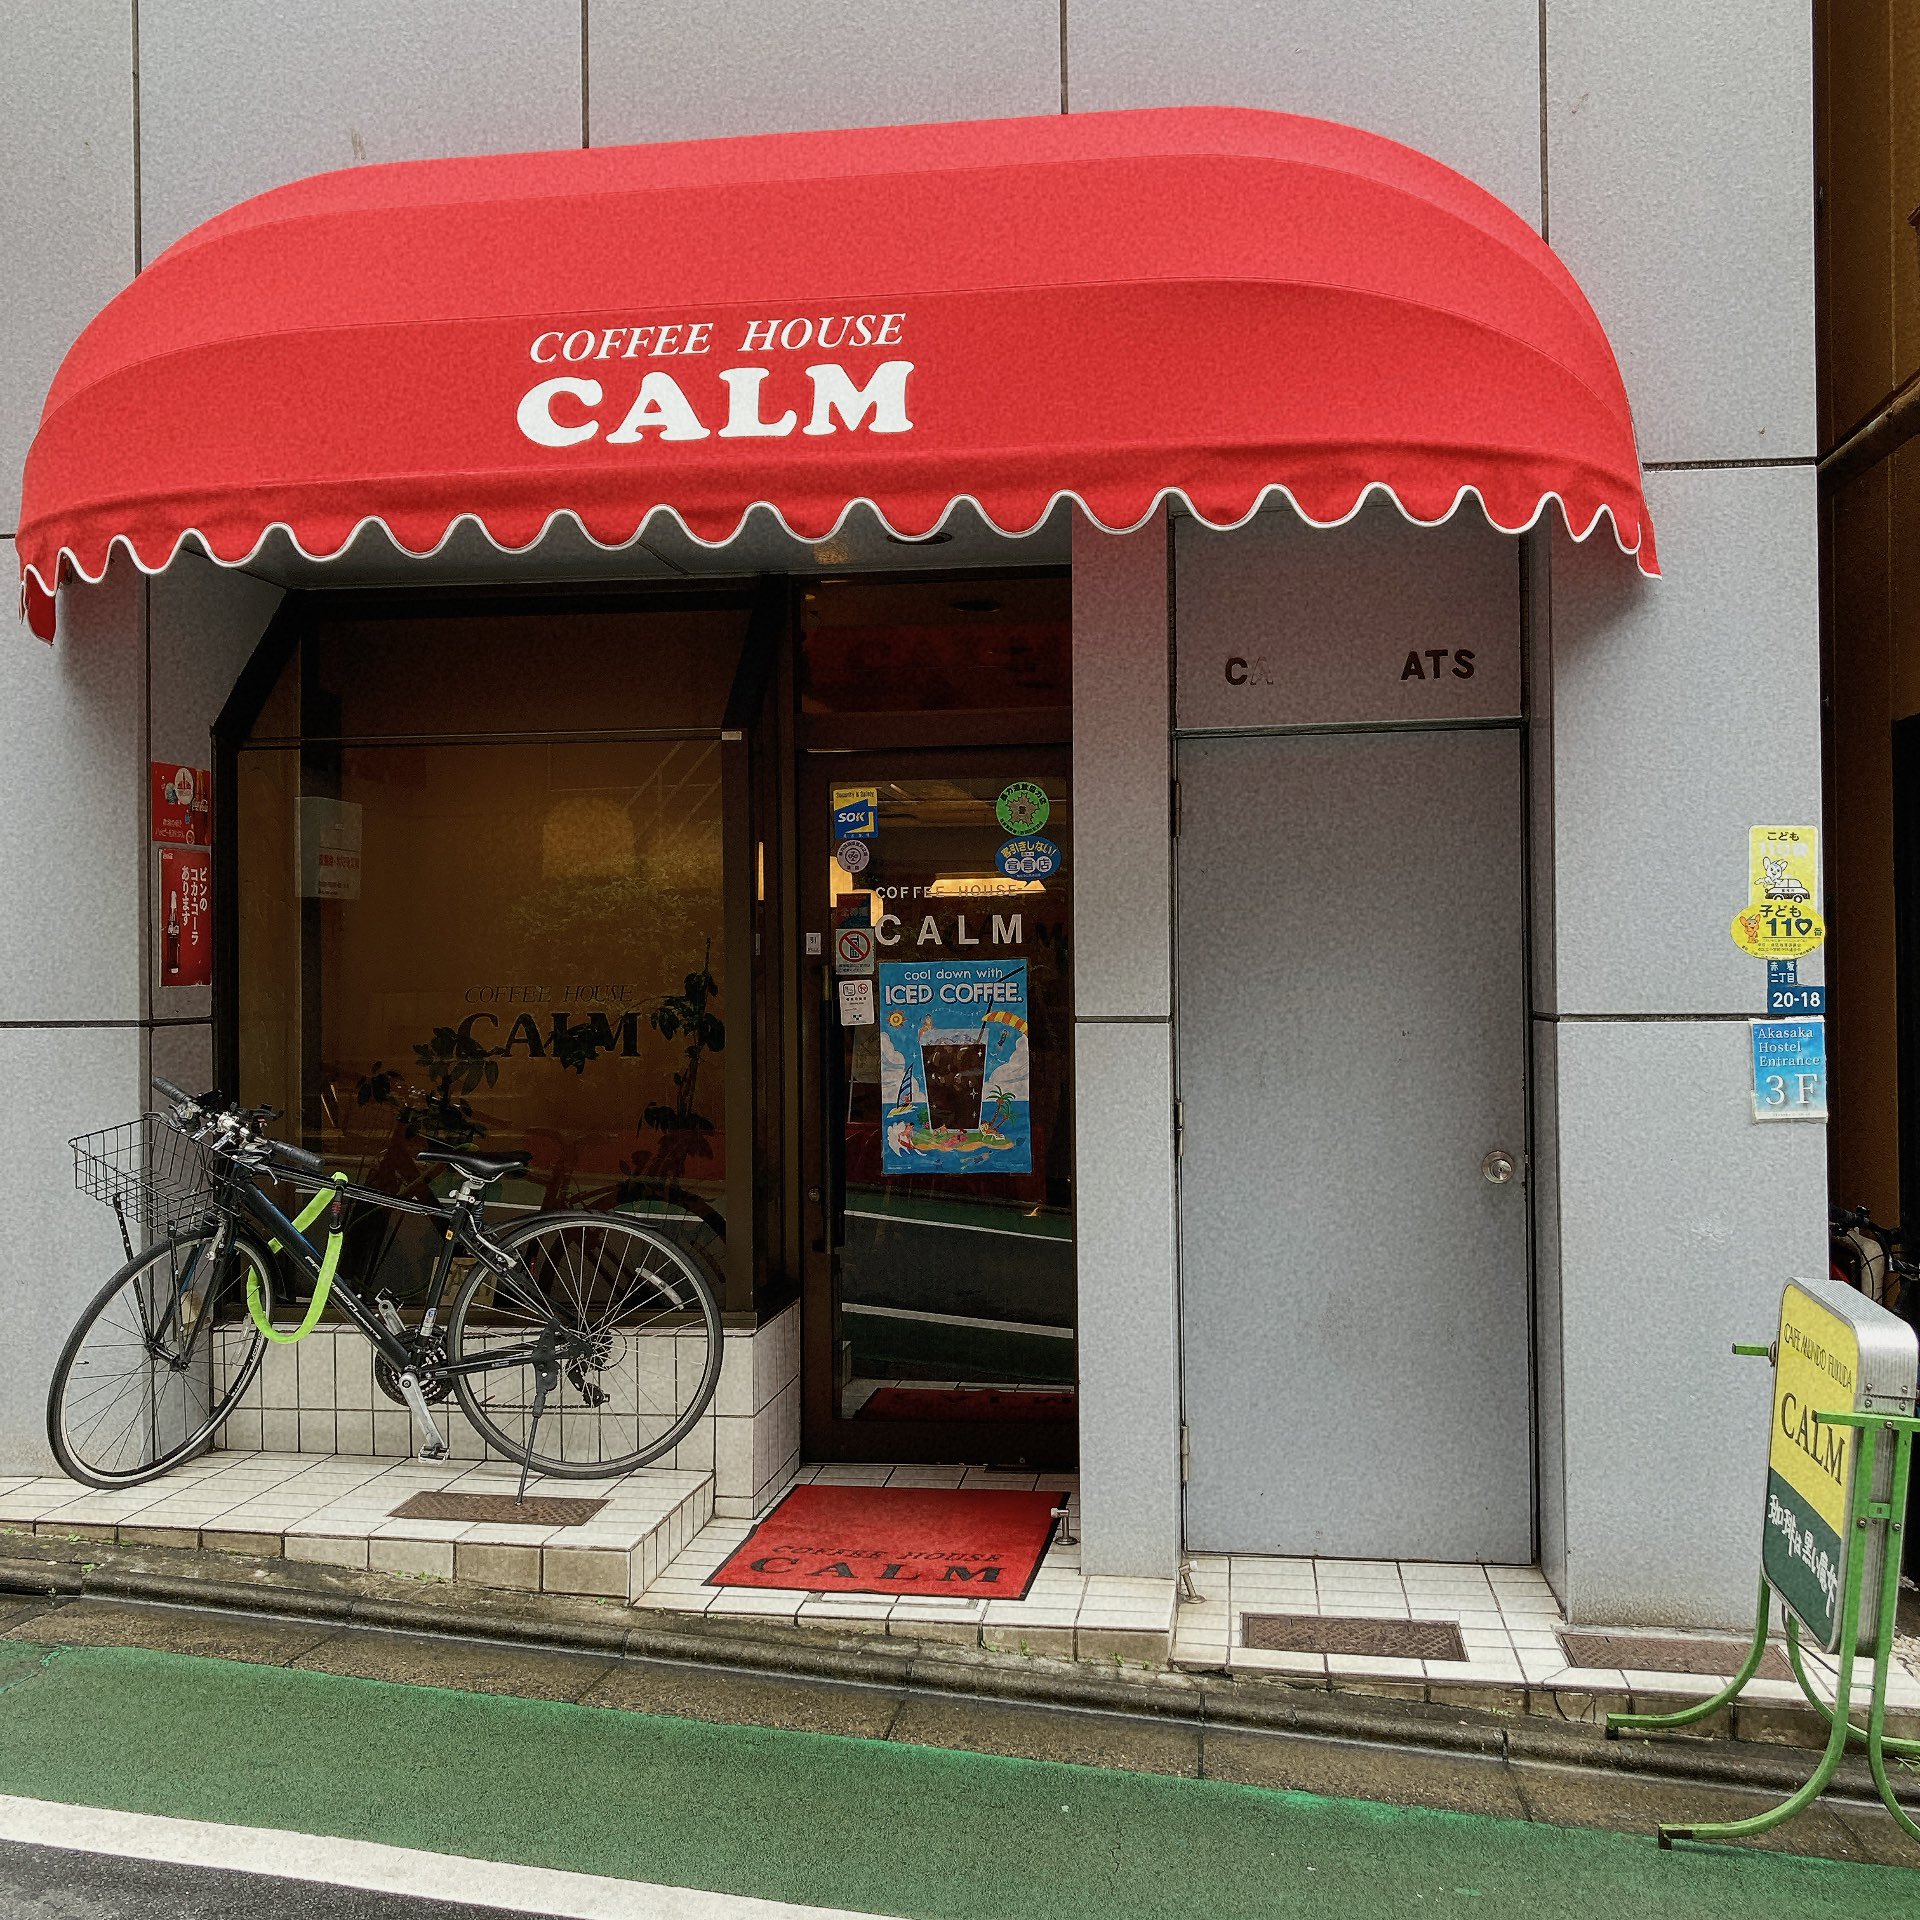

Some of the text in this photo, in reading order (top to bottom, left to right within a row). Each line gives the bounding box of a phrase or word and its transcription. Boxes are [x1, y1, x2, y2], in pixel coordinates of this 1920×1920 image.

[529, 313, 907, 363] COFFEE HOUSE
[516, 360, 915, 447] CALM
[1400, 648, 1476, 681] ATS
[1767, 831, 1800, 842] こども
[181, 865, 190, 927] あります
[199, 866, 208, 912] ビンの
[876, 885, 945, 899] COFFEE
[1759, 904, 1802, 918] 子ども
[875, 913, 1023, 946] CALM
[904, 968, 1003, 981] cool down with
[1770, 972, 1795, 983] 二丁目
[465, 984, 634, 1003] COFFEE HOUSE
[885, 982, 1024, 1005] ICED COFFEE.
[1772, 991, 1821, 1009] 20-18
[1758, 1026, 1814, 1039] Akasaka
[1758, 1040, 1802, 1053] Hostel
[1759, 1055, 1821, 1067] Entrance
[1781, 1391, 1846, 1487] CALM
[896, 1550, 1004, 1563] HOUSE
[749, 1556, 1004, 1583] CALM
